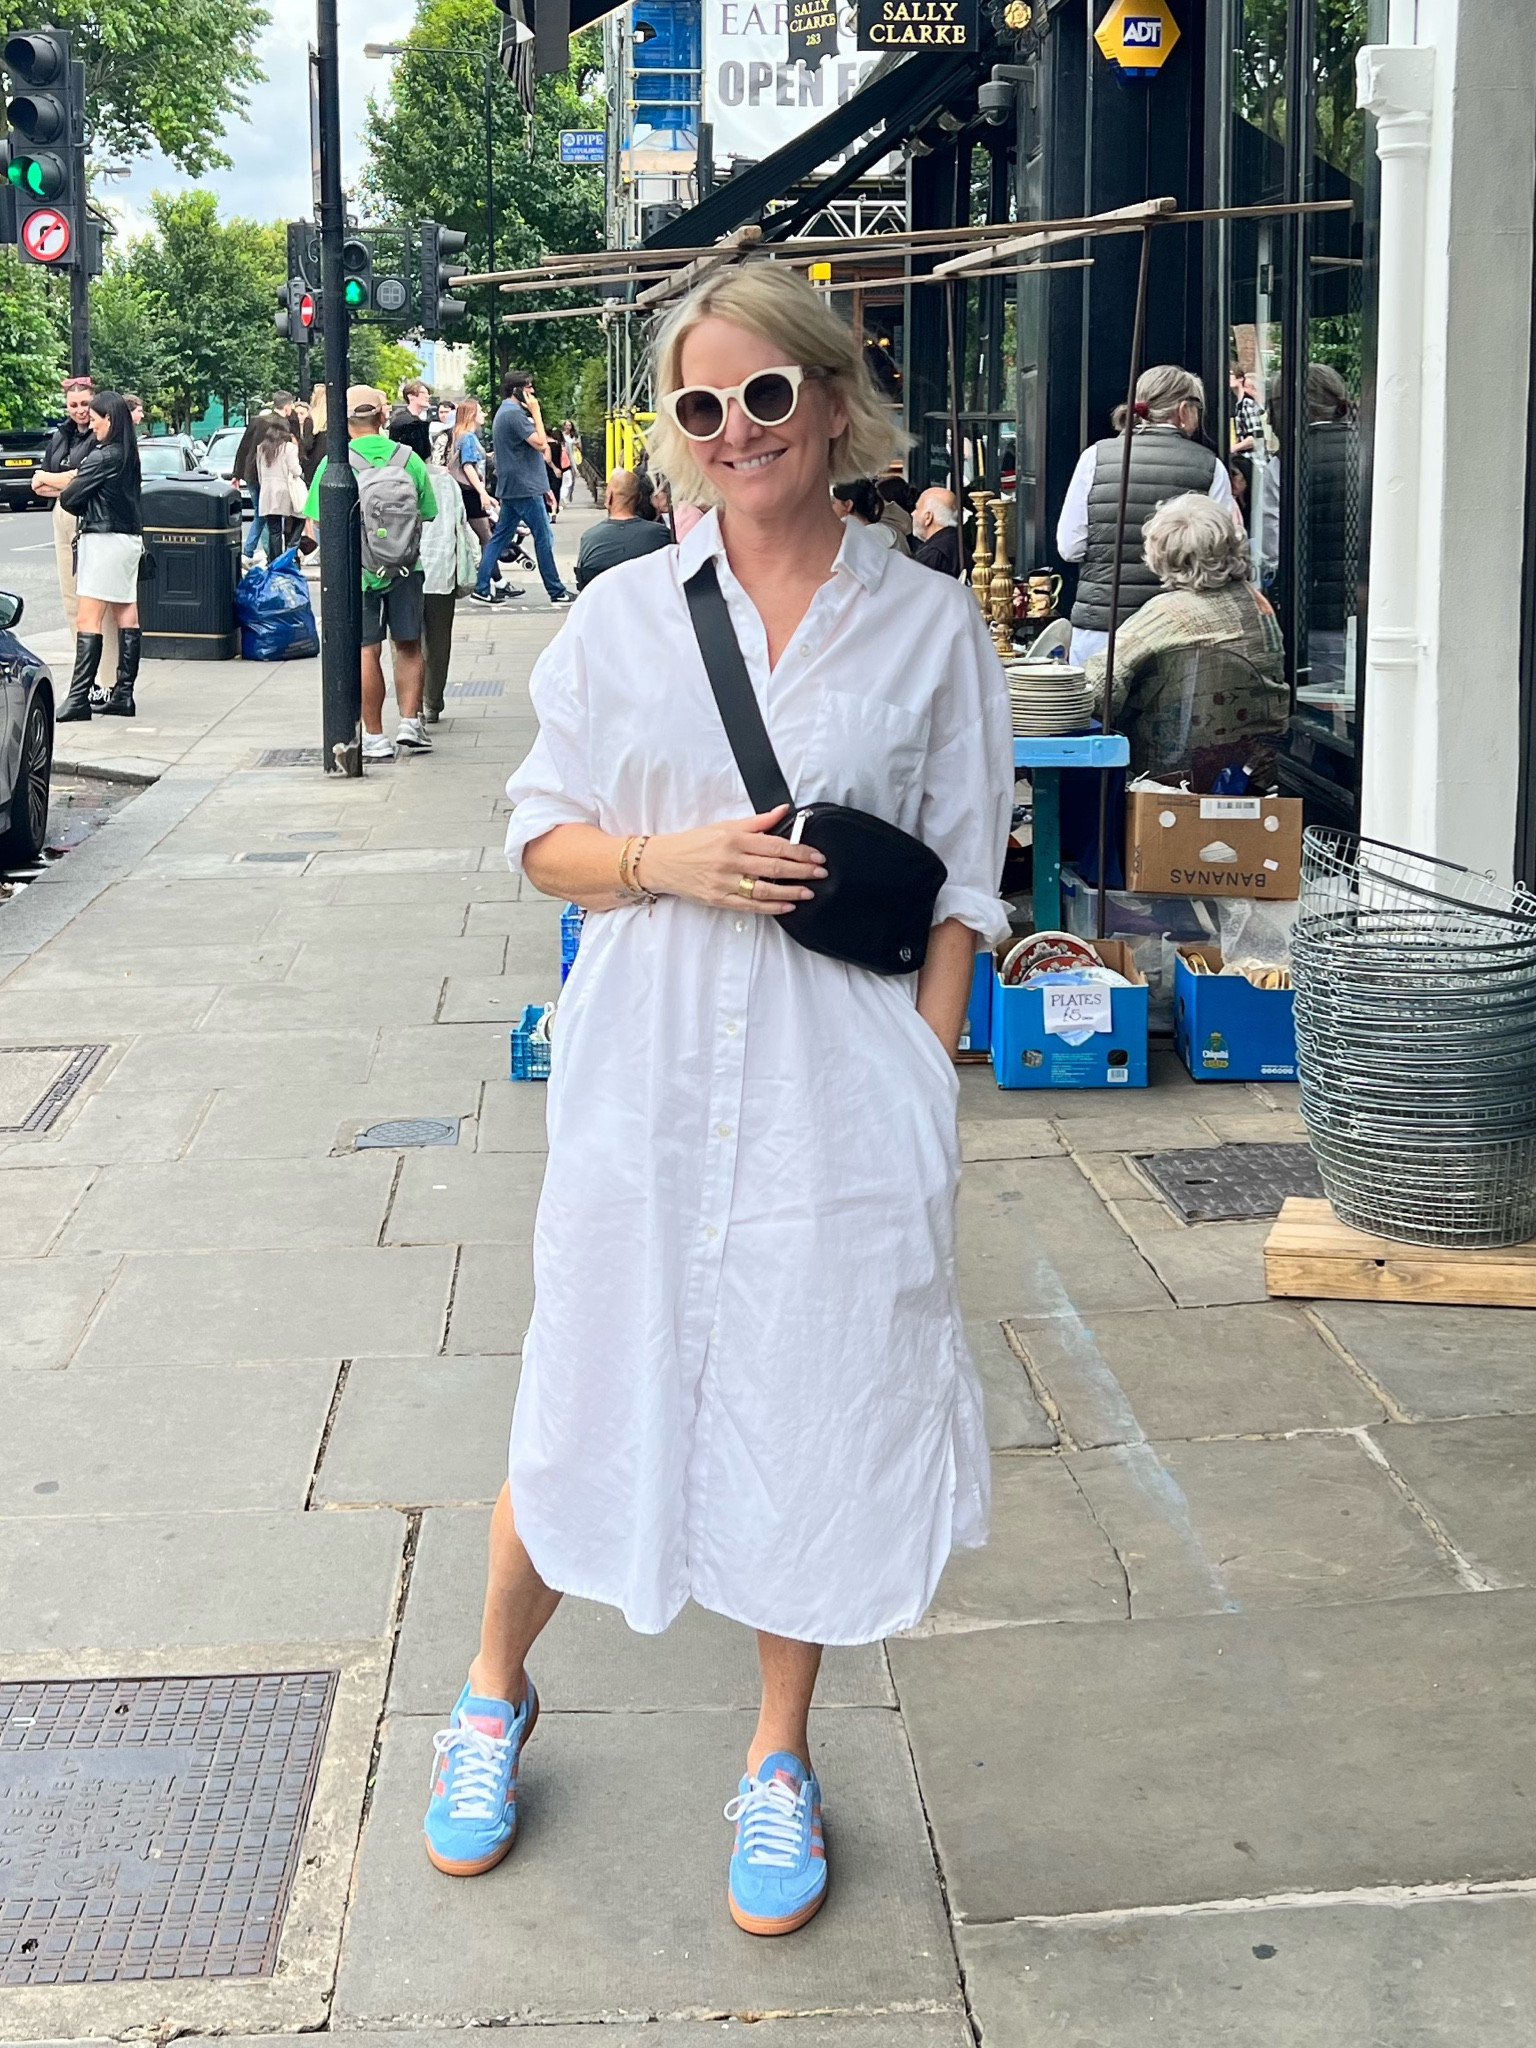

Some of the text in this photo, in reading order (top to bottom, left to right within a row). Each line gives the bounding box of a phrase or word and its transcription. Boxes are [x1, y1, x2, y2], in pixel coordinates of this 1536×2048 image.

[794, 0, 830, 17] SALLY
[883, 2, 959, 21] SALLY
[789, 13, 836, 33] CLARKE
[1122, 22, 1162, 42] ADT
[805, 33, 822, 46] 283
[869, 24, 966, 45] CLARKE
[718, 60, 824, 107] OPEN
[576, 134, 605, 146] PIPE
[162, 535, 197, 543] LITTER
[1170, 868, 1267, 888] BANANAS
[1051, 993, 1103, 1007] PLATES
